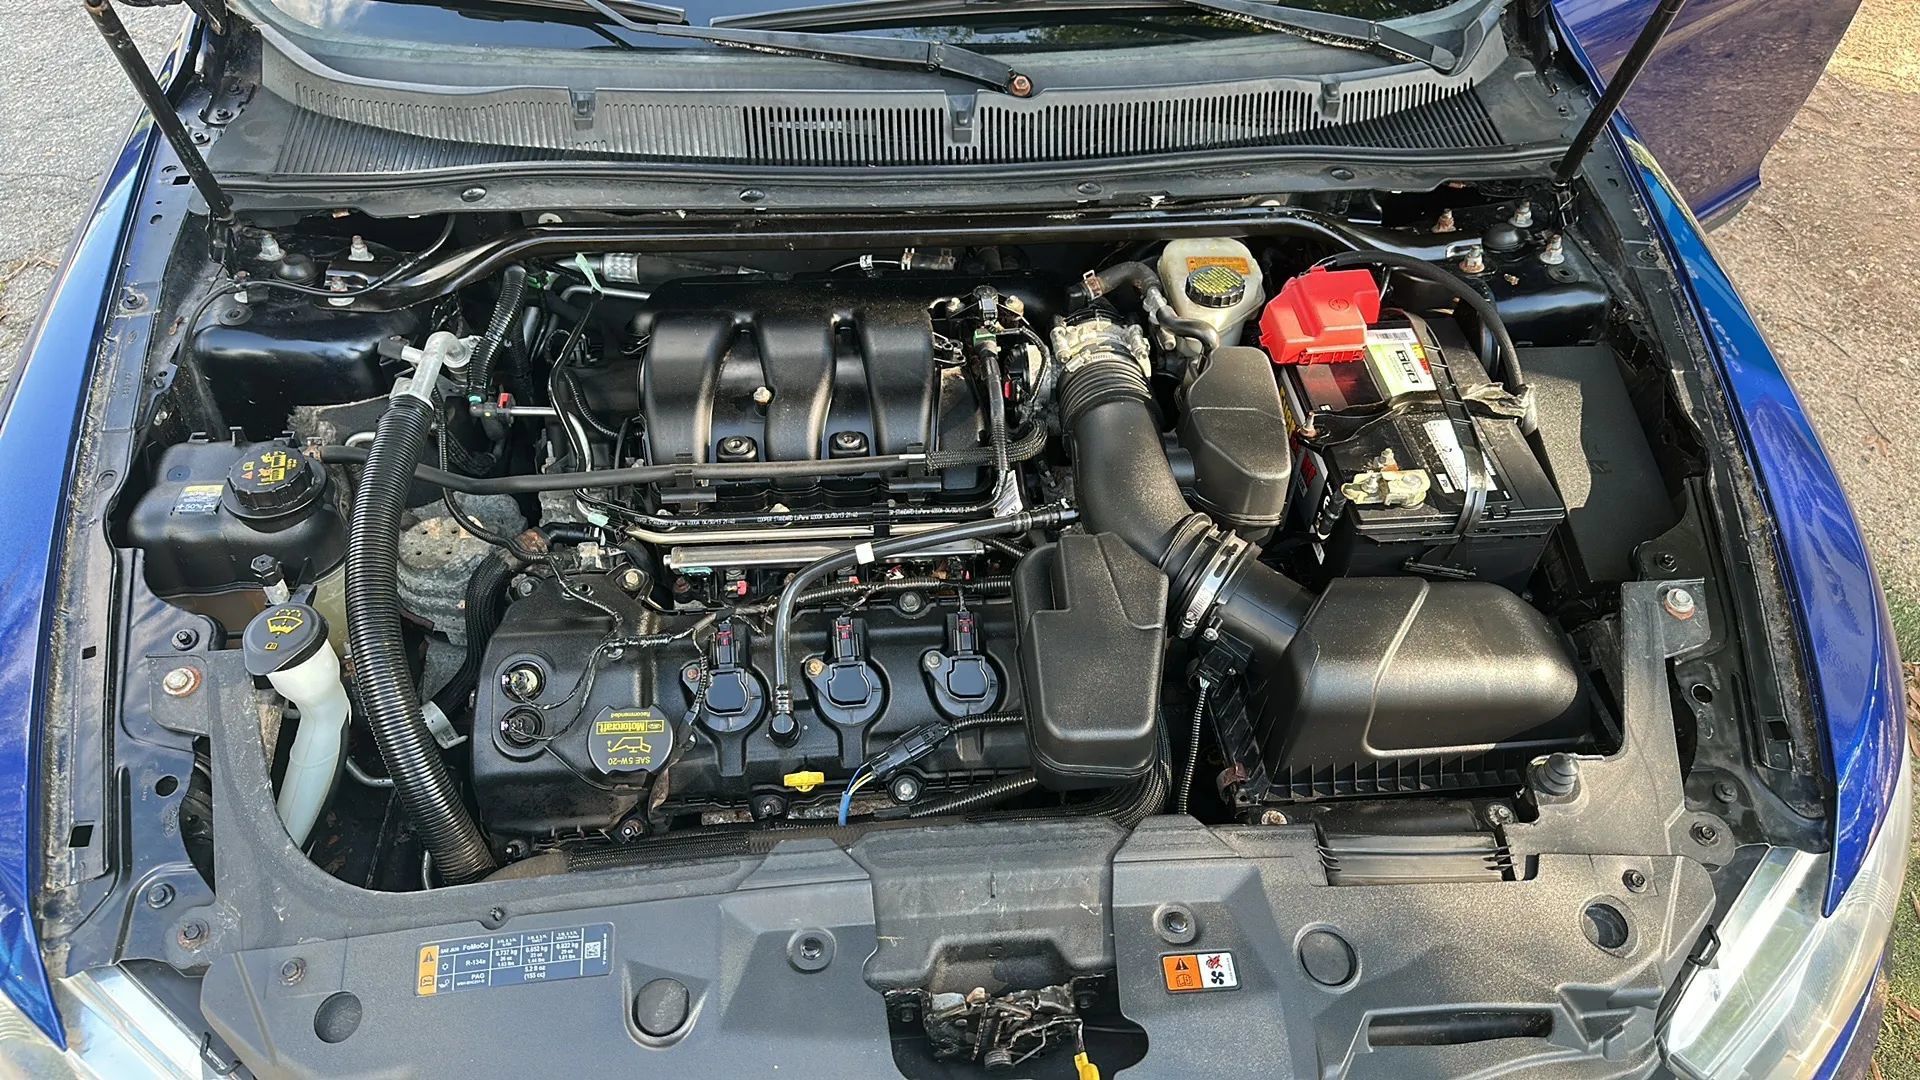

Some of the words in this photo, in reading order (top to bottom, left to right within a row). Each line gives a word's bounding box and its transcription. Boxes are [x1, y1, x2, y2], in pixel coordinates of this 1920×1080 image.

[599, 722, 646, 733] Motorcraft
[607, 756, 634, 766] 5W-20
[634, 756, 651, 765] SAE
[463, 942, 489, 951] FoMoCo
[465, 958, 486, 966] R-134a
[471, 972, 485, 980] PAG
